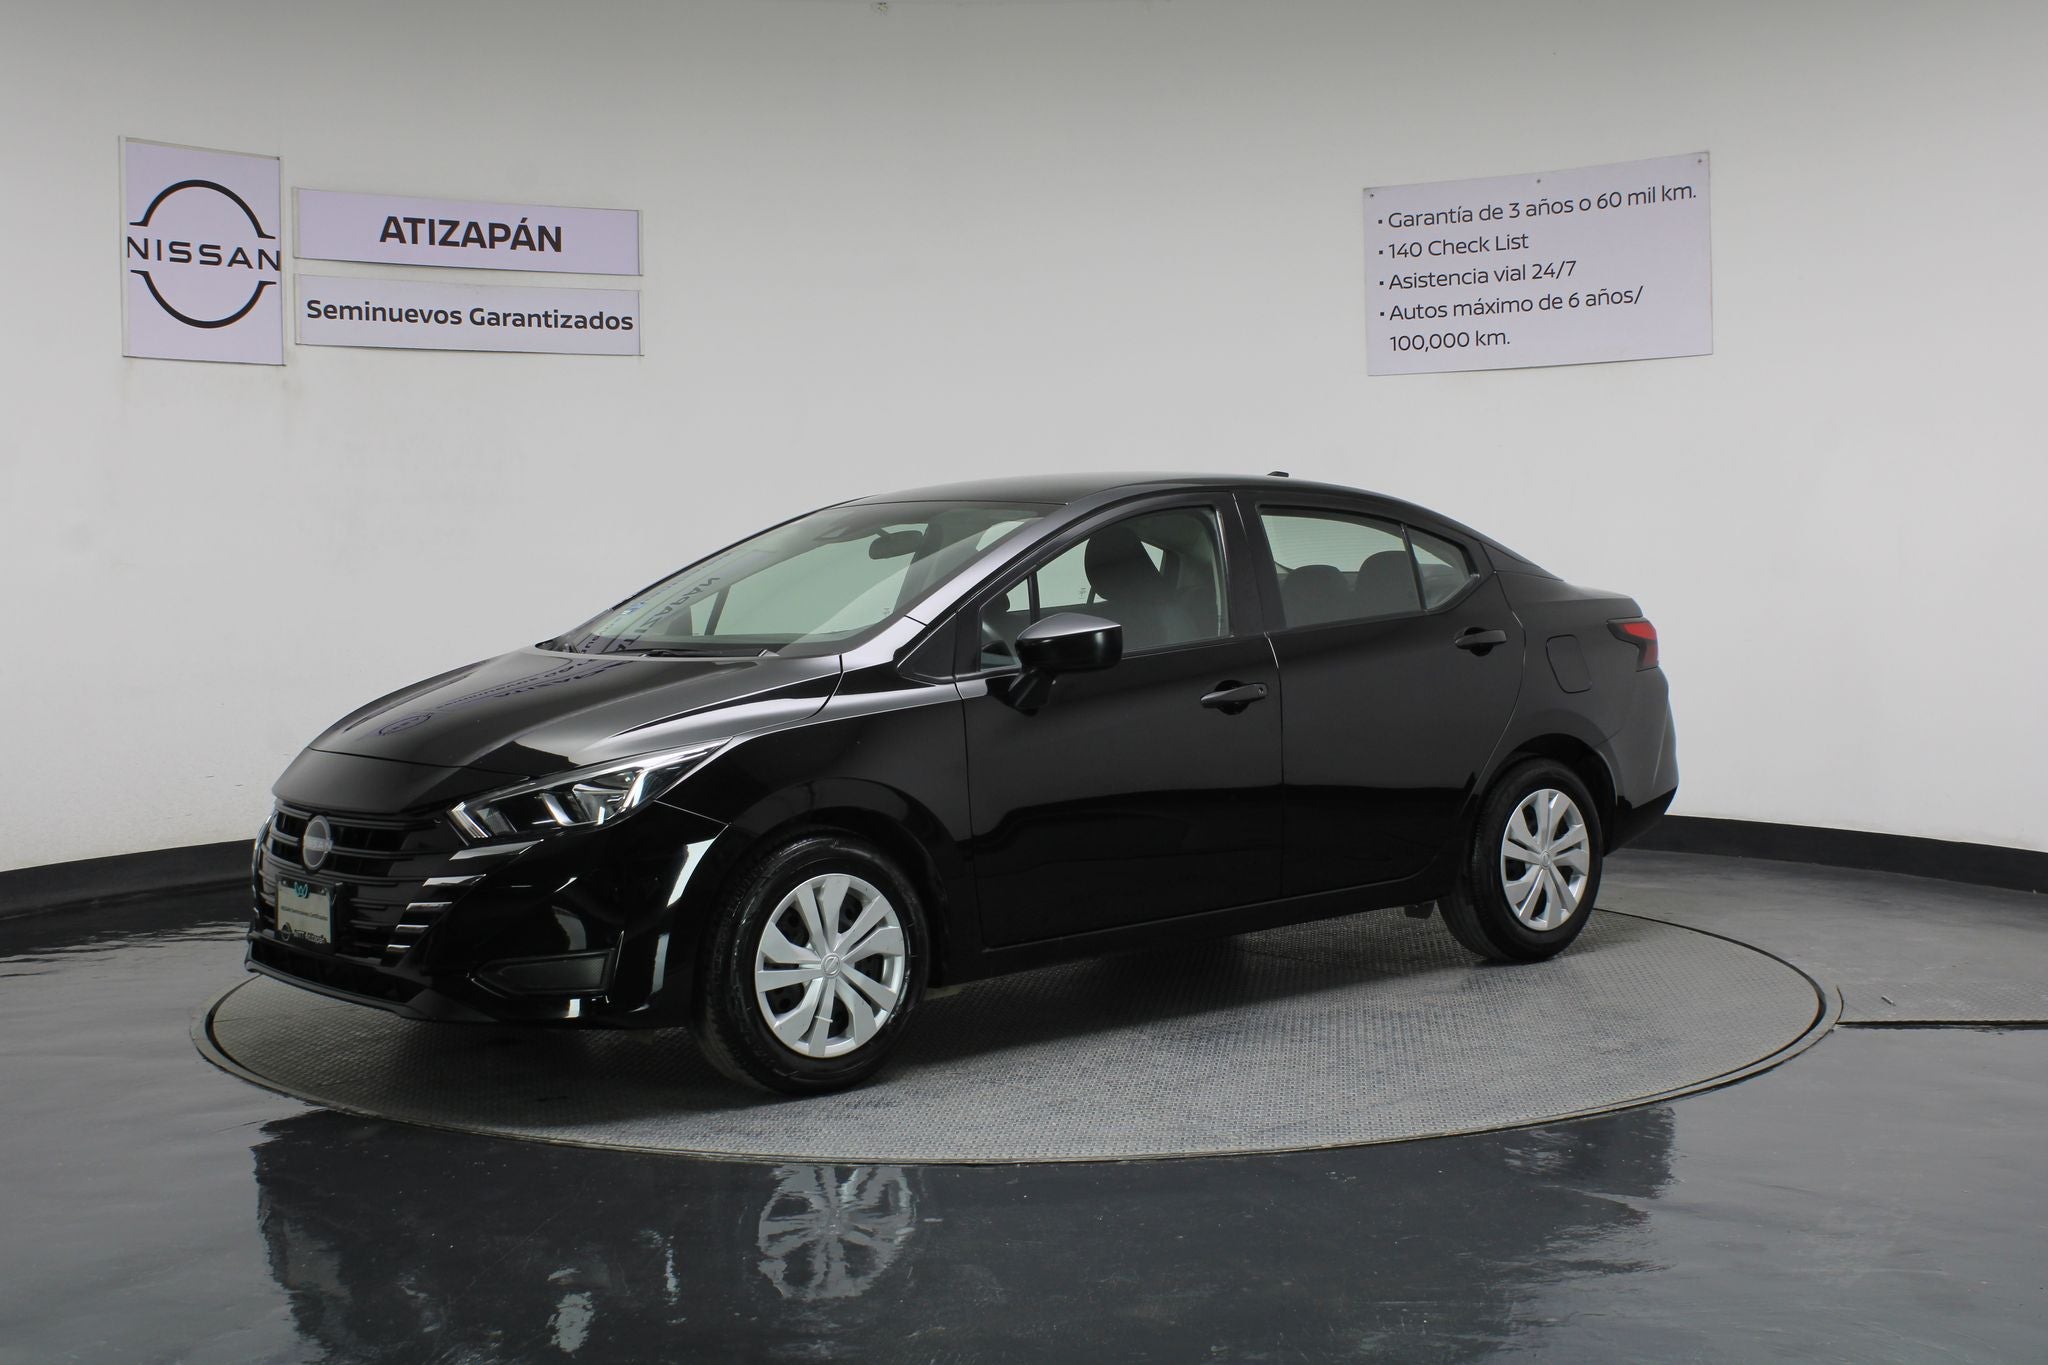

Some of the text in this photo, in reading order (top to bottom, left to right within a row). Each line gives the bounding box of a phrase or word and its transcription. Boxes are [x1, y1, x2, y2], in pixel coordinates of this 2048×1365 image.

[1388, 184, 1697, 229] Garantía de 3 años o 60 mil km.
[379, 215, 562, 253] ATIZAPÁN
[1388, 233, 1530, 259] 140 Check List
[126, 235, 282, 273] NISSAN
[1388, 260, 1577, 290] Asistencia vial 24/7
[306, 299, 634, 331] Seminuevos Garantizados
[1389, 285, 1644, 321] Autos máximo de 6 años/
[1389, 330, 1511, 353] 100,000 km.
